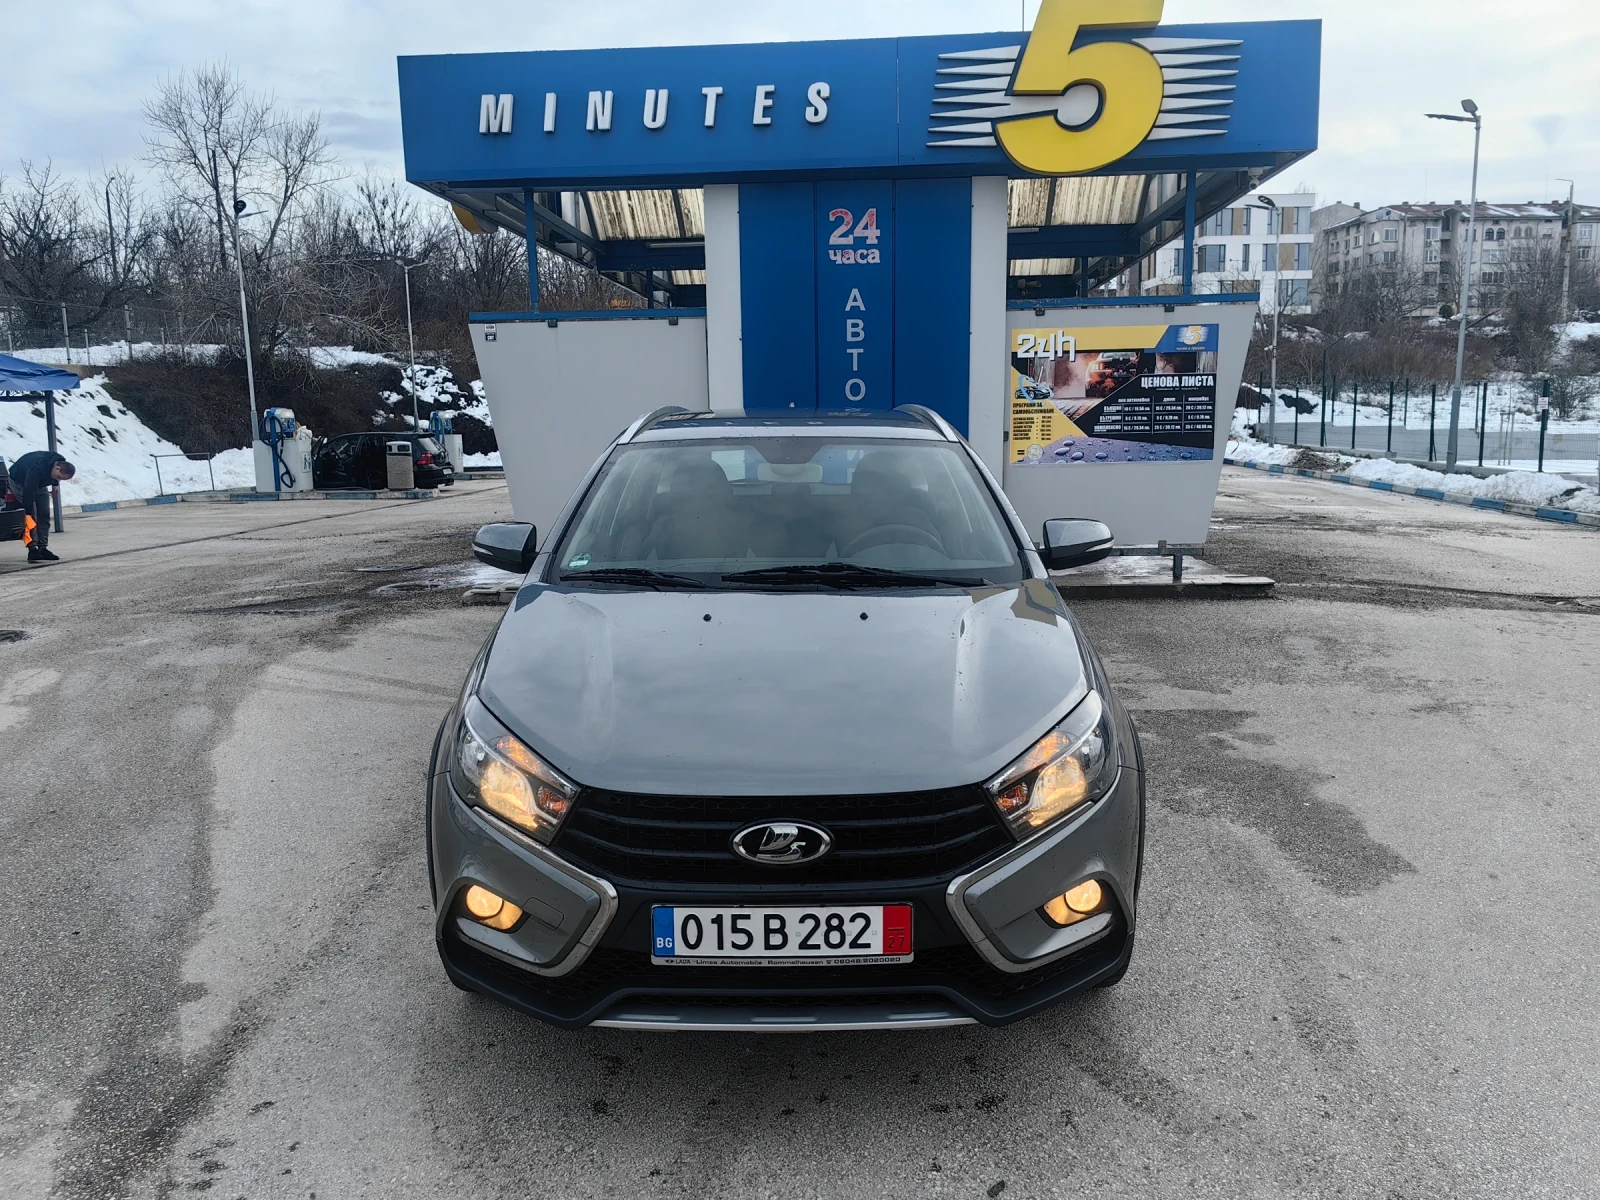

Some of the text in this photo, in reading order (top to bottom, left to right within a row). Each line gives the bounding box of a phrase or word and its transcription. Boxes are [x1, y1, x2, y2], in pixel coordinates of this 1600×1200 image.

[995, 0, 1165, 175] 5
[478, 81, 831, 135] MINUTES
[829, 208, 881, 245] 24
[828, 248, 881, 265] часа
[844, 288, 866, 404] АВТО
[1017, 330, 1076, 362] 24h
[1183, 325, 1202, 345] 5
[1141, 375, 1214, 389] ЦЕНОВА ЛИСТА
[656, 937, 673, 949] BG
[888, 936, 905, 949] 27
